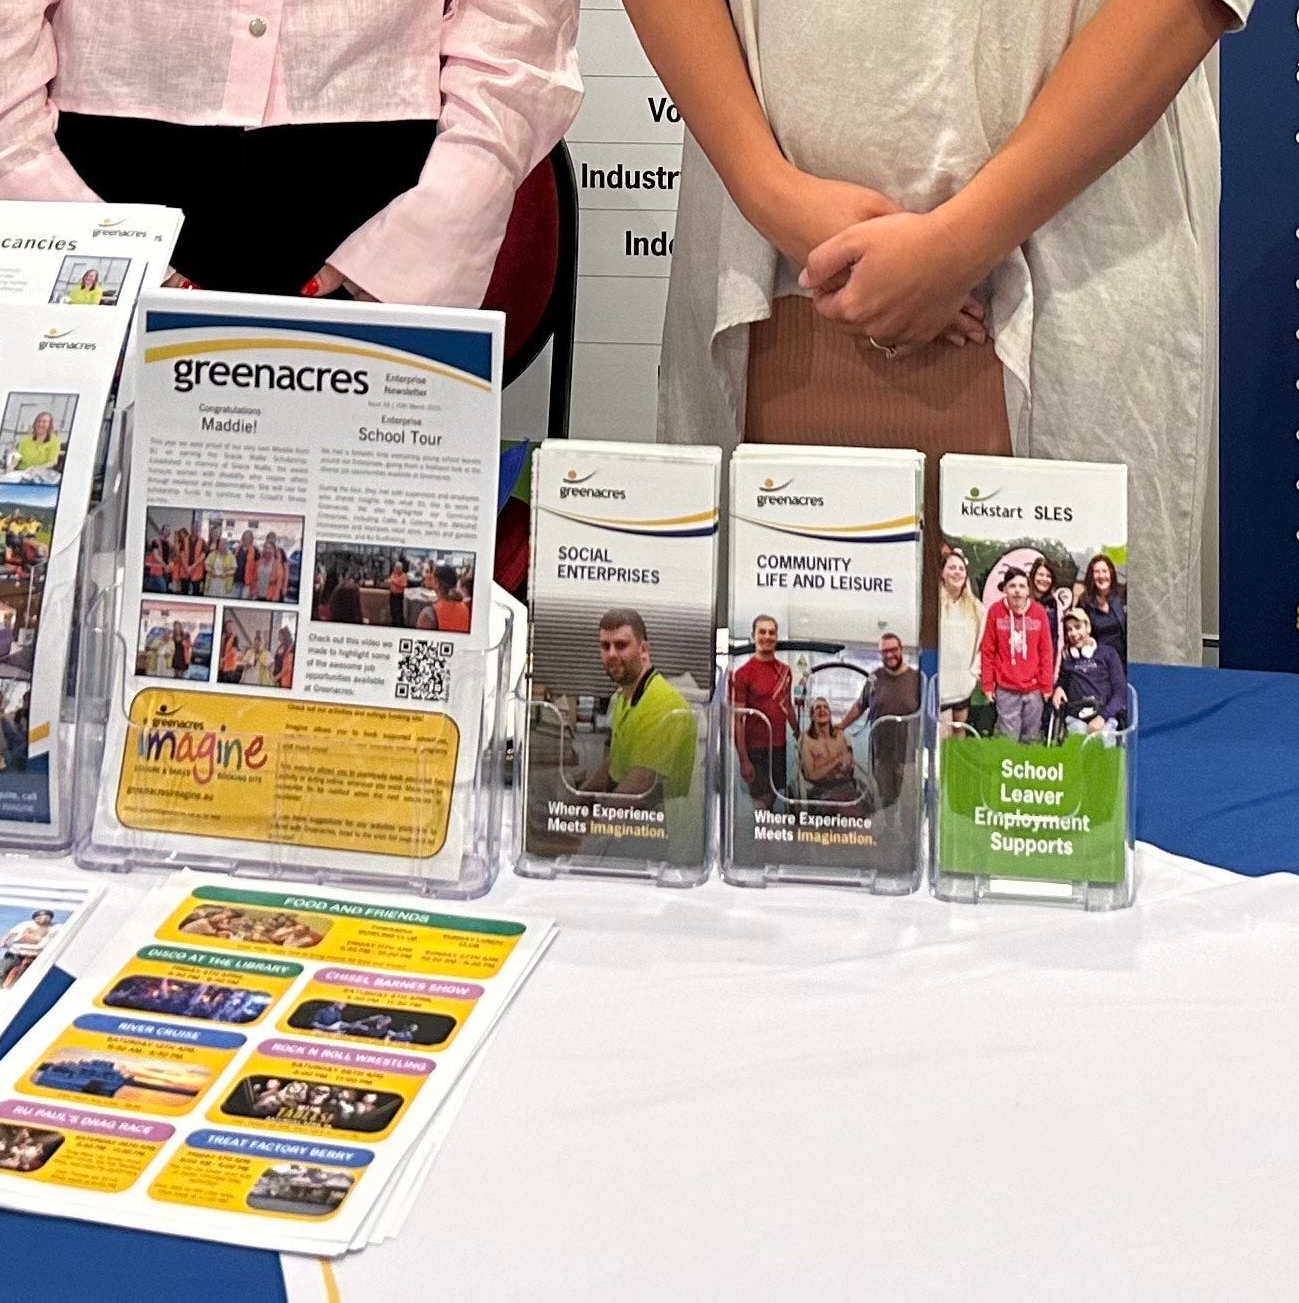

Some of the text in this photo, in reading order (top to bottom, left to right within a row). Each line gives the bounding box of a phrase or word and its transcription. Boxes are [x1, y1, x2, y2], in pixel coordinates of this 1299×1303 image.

[625, 231, 676, 256] Ind
[38, 340, 96, 351] greenacres
[174, 359, 369, 395] greenacres
[202, 417, 257, 434] Maddie!
[359, 427, 442, 446] School Tour
[559, 485, 626, 500] greenacres
[756, 493, 824, 508] greenacres
[961, 501, 1073, 522] kickstart SLES
[558, 546, 612, 563] SOCIAL
[756, 554, 851, 572] COMMUNITY
[557, 563, 660, 585] ENTERPRISES
[756, 572, 893, 592] LIFE AND LEISURE
[152, 717, 204, 730] greenacres
[136, 717, 267, 785] imagine
[1001, 759, 1064, 782] School
[1000, 782, 1064, 806] Leaver
[548, 800, 664, 822] Where Experience
[754, 809, 872, 829] Where Experience
[975, 807, 1090, 834] Employment
[547, 817, 669, 839] Meets Imagination.
[754, 826, 877, 847] Meets Imagination.
[991, 832, 1073, 856] Supports
[282, 897, 430, 923] FOOD AND FRIENDS
[148, 948, 291, 974] DISCO AT THE LIBRARY
[325, 970, 469, 996] CHISEL BARNES SHOW
[118, 1022, 201, 1040] RIVER CRUISE
[272, 1042, 427, 1071] ROCK N ROLL WRESTLING
[80, 1116, 116, 1129] DRAG
[119, 1123, 153, 1135] RACE
[207, 1134, 354, 1161] TREAT FACTORY BERRY
